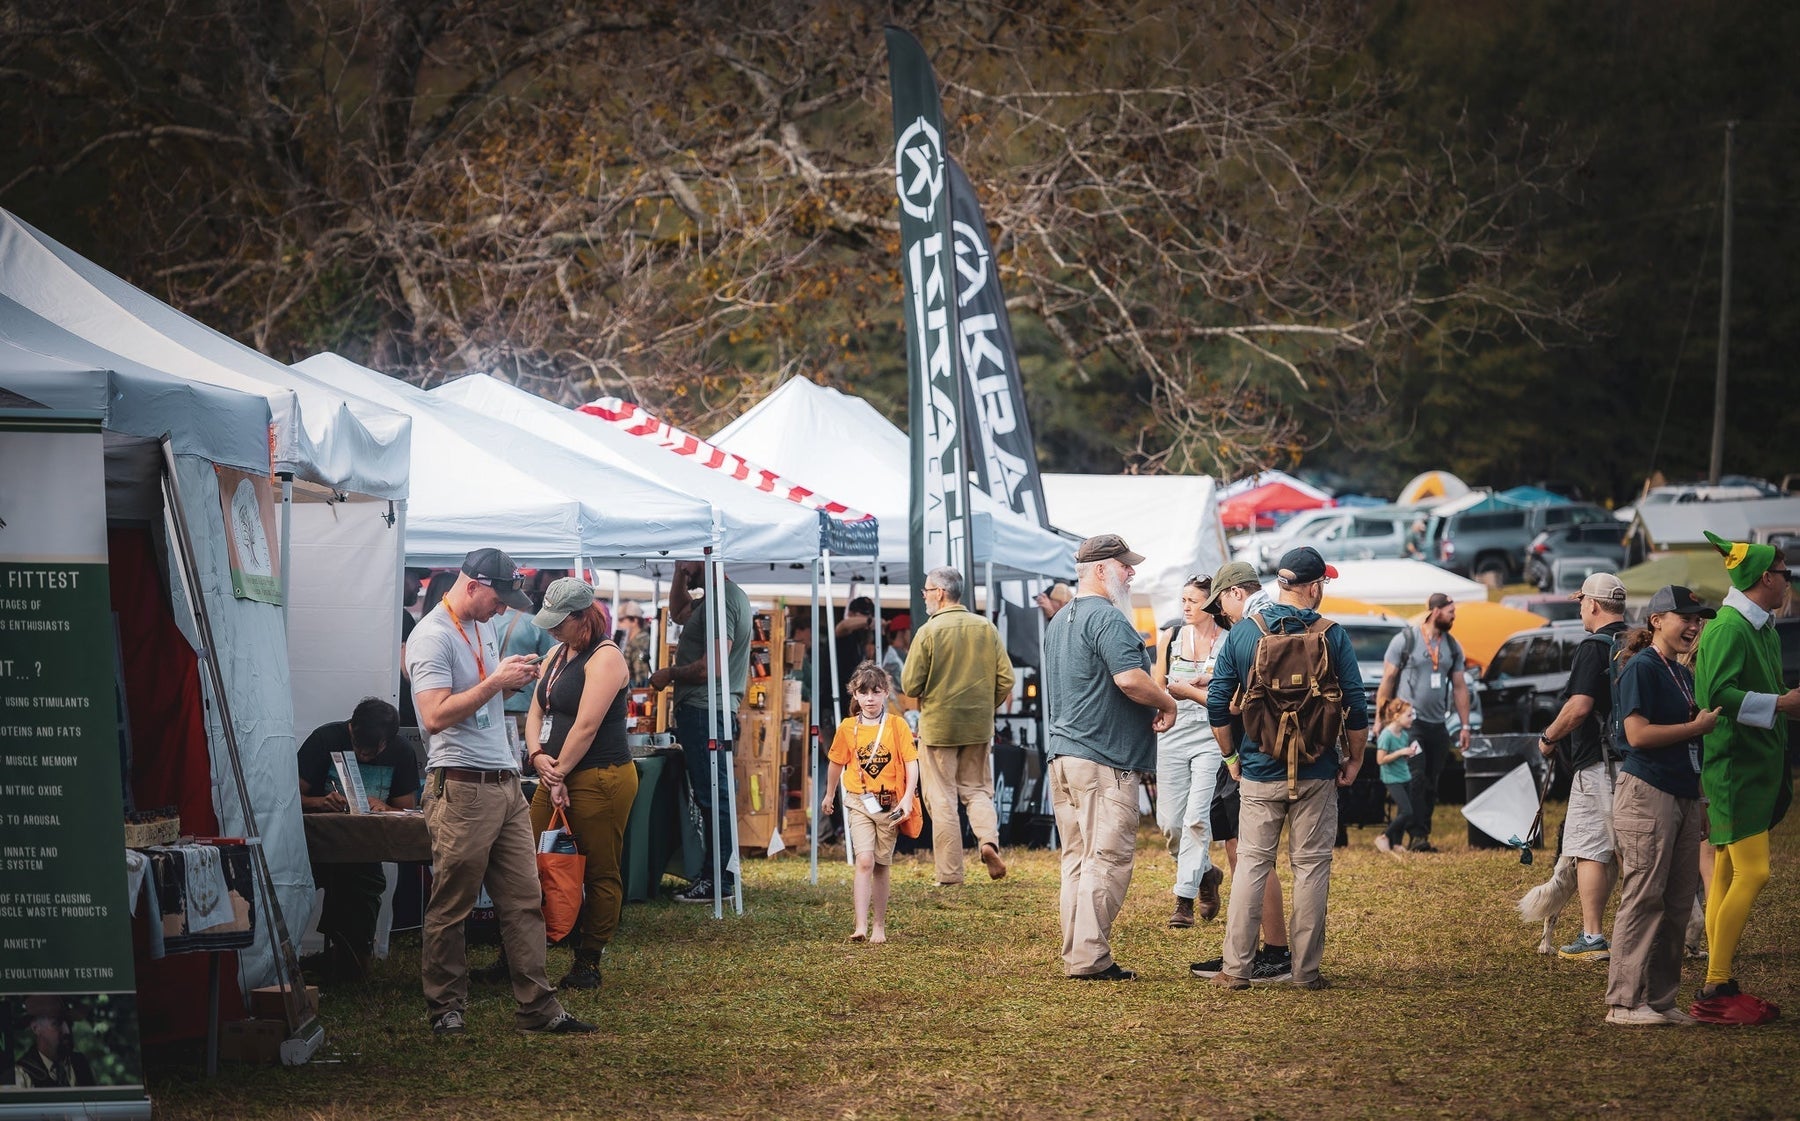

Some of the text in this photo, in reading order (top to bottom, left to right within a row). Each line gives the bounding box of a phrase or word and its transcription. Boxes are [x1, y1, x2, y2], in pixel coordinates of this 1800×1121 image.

[9, 571, 80, 589] FITTEST
[31, 600, 42, 611] OF
[10, 620, 70, 632] ENTHUSIASTS
[6, 697, 90, 708] USING STIMULANTS
[37, 727, 54, 737] AND
[57, 727, 82, 737] FATS
[6, 756, 78, 767] MUSCLE MEMORY
[6, 785, 63, 797] NITRIC OXIDE
[7, 815, 20, 826] TO
[24, 815, 61, 826] AROUSAL
[4, 847, 58, 858] INNATE AND
[7, 860, 44, 871] SYSTEM
[0, 894, 92, 905] OF FATIGUE CAUSING
[26, 907, 59, 918] WASTE
[62, 906, 108, 918] PRODUCTS
[5, 968, 114, 980] EVOLUTIONARY TESTING
